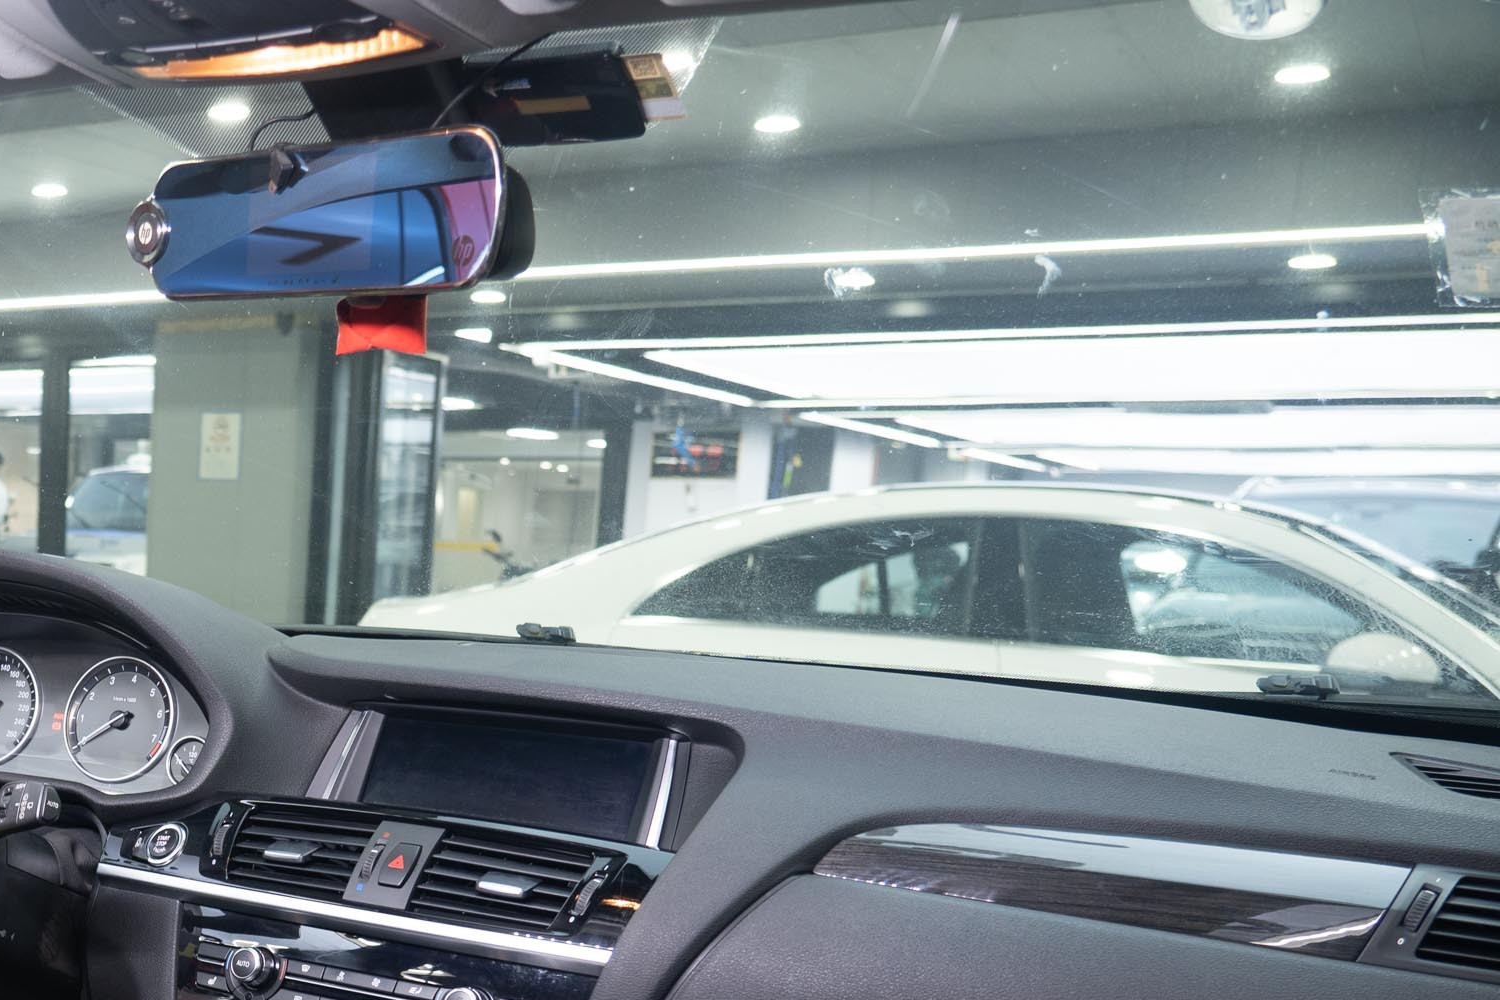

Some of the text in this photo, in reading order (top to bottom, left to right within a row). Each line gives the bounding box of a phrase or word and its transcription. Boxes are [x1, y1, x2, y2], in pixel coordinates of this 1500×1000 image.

[452, 236, 474, 267] hp
[0, 664, 11, 672] 140
[9, 670, 20, 678] 160
[109, 676, 116, 686] 3
[131, 675, 137, 684] 4
[15, 680, 26, 688] 180
[17, 691, 29, 699] 200
[89, 692, 95, 701] 2
[150, 688, 156, 697] 5
[18, 703, 29, 712] 220
[80, 714, 85, 722] 1
[156, 710, 162, 719] 6
[13, 717, 25, 726] 240
[5, 730, 18, 738] 260
[151, 734, 157, 742] 7
[188, 751, 198, 759] 120
[47, 800, 59, 809] AUTO
[236, 960, 250, 968] AUTO
